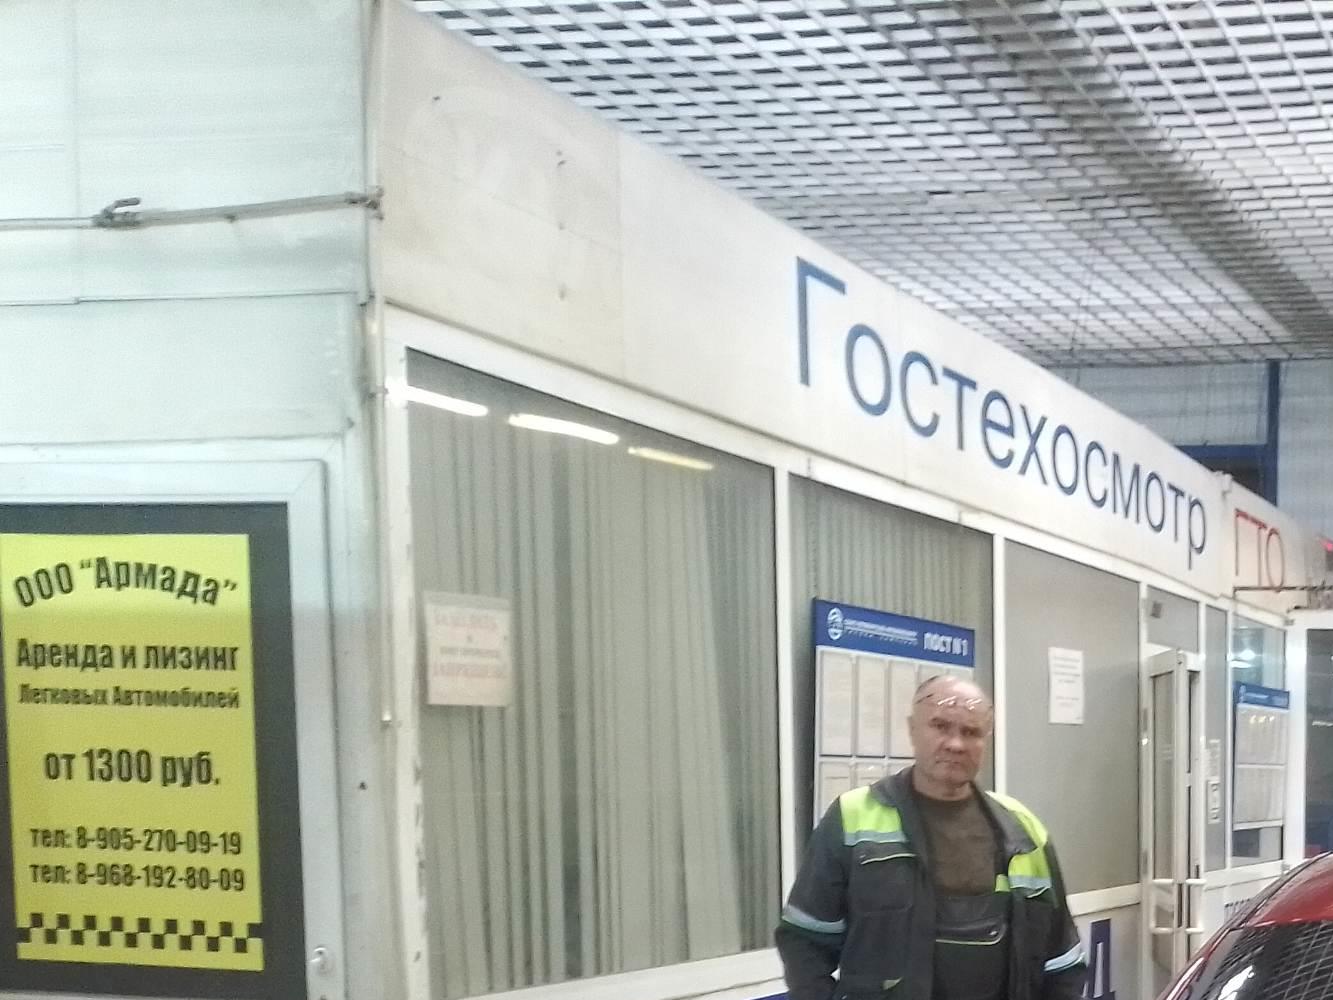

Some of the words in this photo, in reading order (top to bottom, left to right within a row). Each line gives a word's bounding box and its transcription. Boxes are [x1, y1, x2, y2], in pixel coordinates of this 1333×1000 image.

[795, 255, 1208, 571] Гостехосмотр
[14, 562, 74, 607] ООО
[16, 638, 113, 672] Аренда
[121, 645, 136, 669] и
[144, 645, 239, 671] лизинг
[112, 685, 240, 709] Автомобилей
[44, 753, 76, 781] от
[82, 748, 152, 784] 1300
[160, 751, 220, 788] руб.
[76, 826, 242, 855] 8-905-270-09-19
